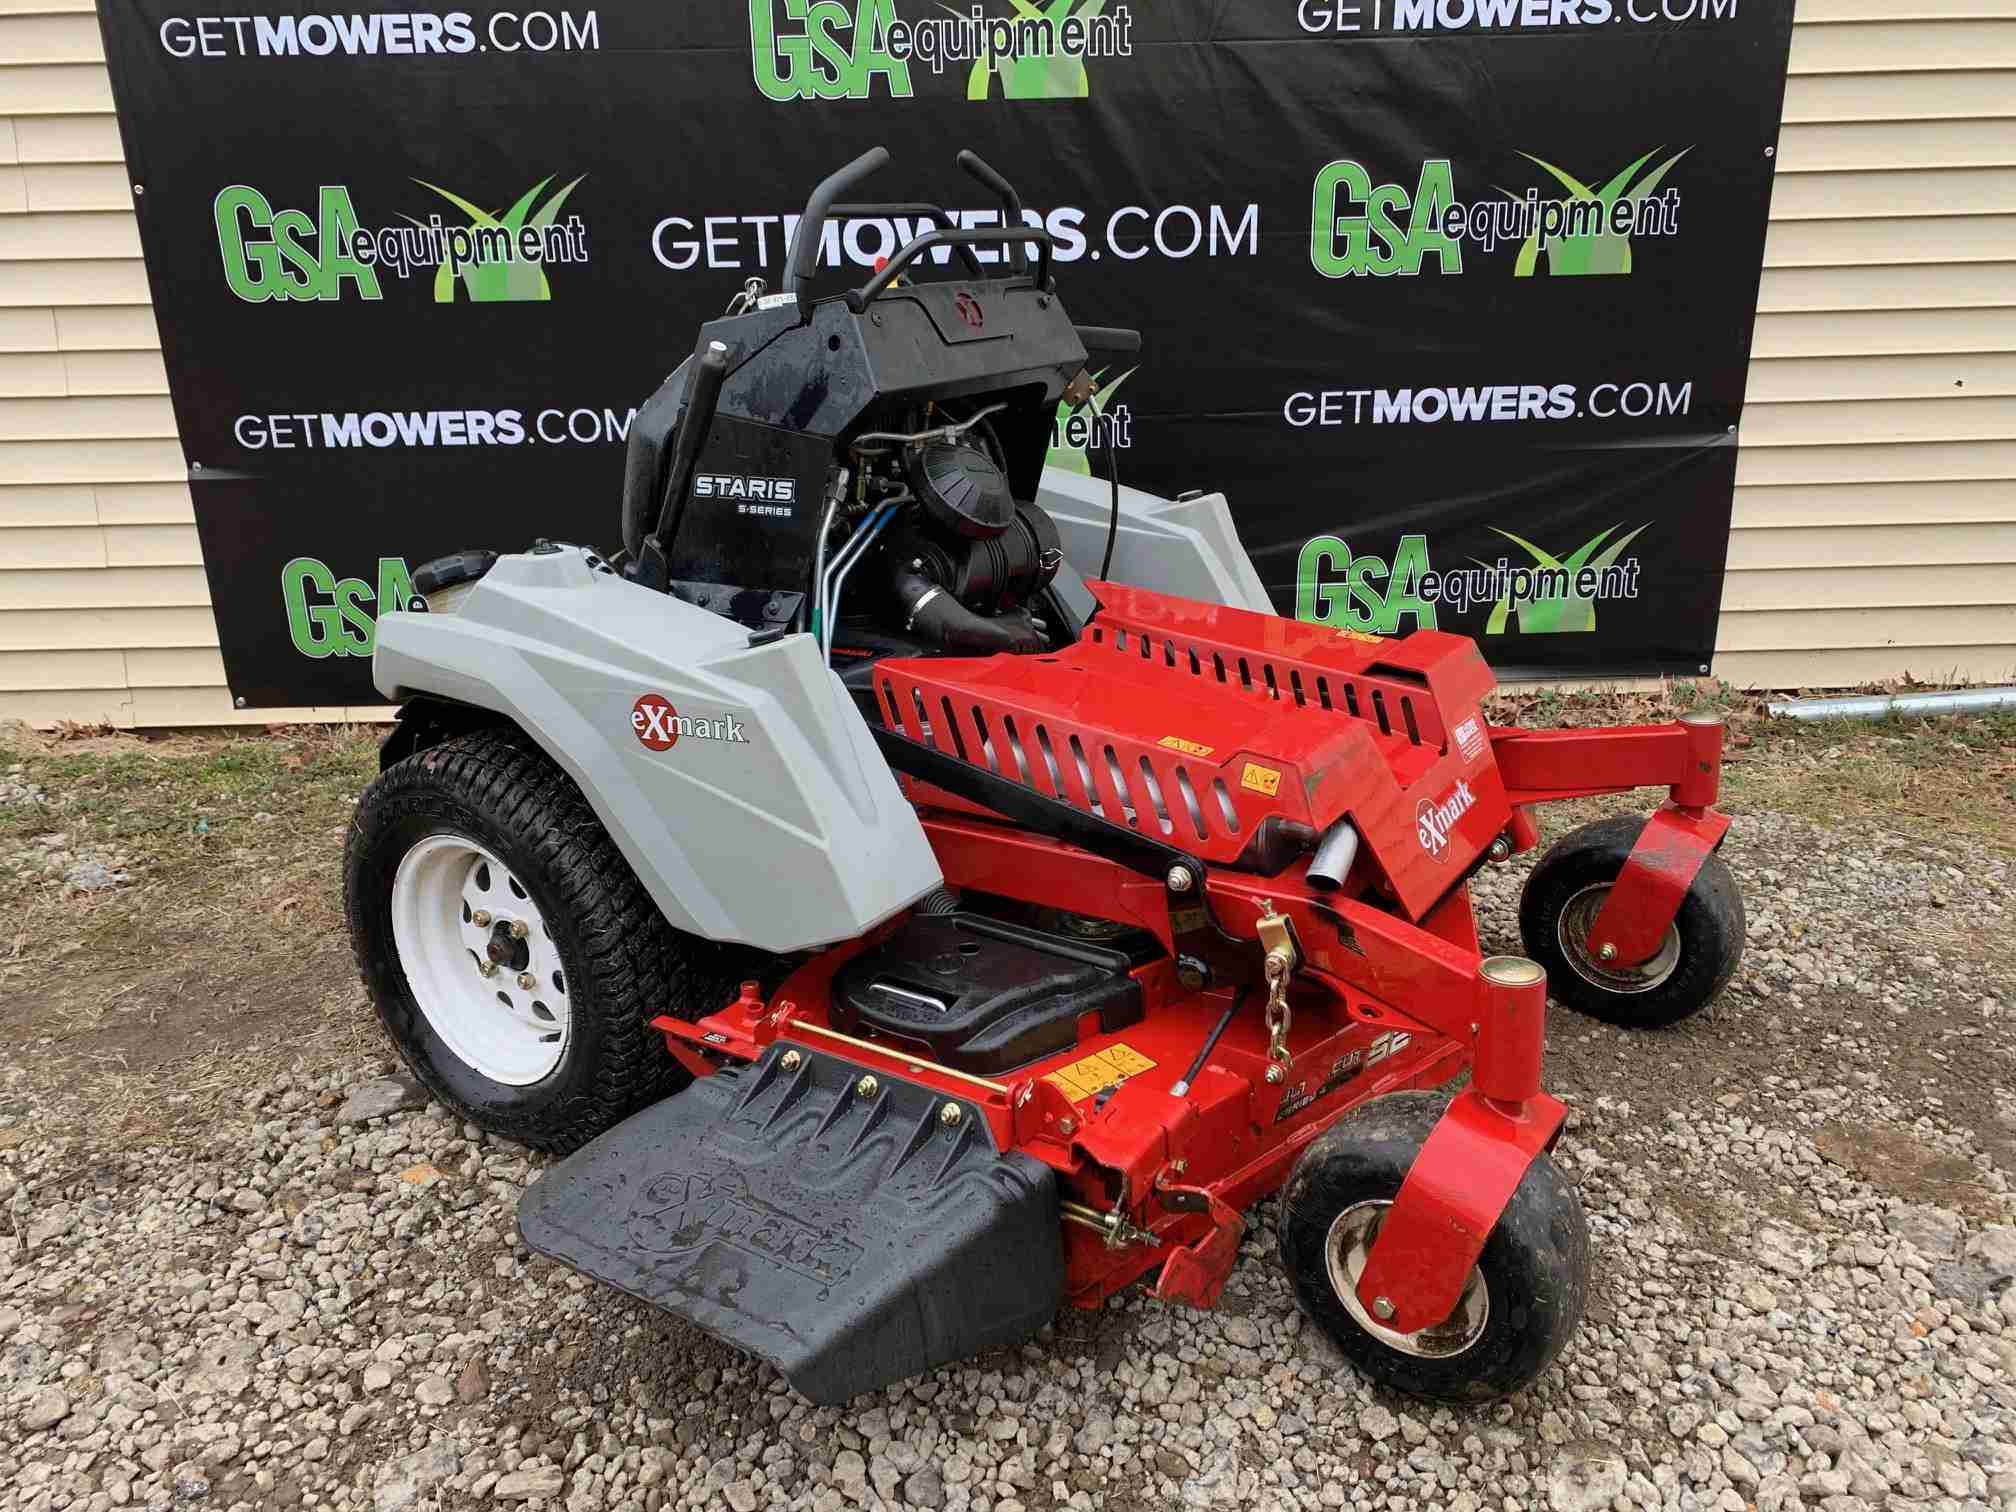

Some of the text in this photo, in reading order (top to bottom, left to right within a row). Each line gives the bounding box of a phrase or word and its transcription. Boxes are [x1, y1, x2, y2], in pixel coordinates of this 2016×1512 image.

[159, 11, 600, 57] GETMOWERS.COM
[885, 5, 1132, 73] equipment
[349, 215, 589, 279] equipment
[1439, 187, 1681, 253] equipment
[1283, 381, 1693, 427] GETMOWERS.COM
[695, 475, 795, 501] STARIS
[1416, 557, 1642, 613] equipment
